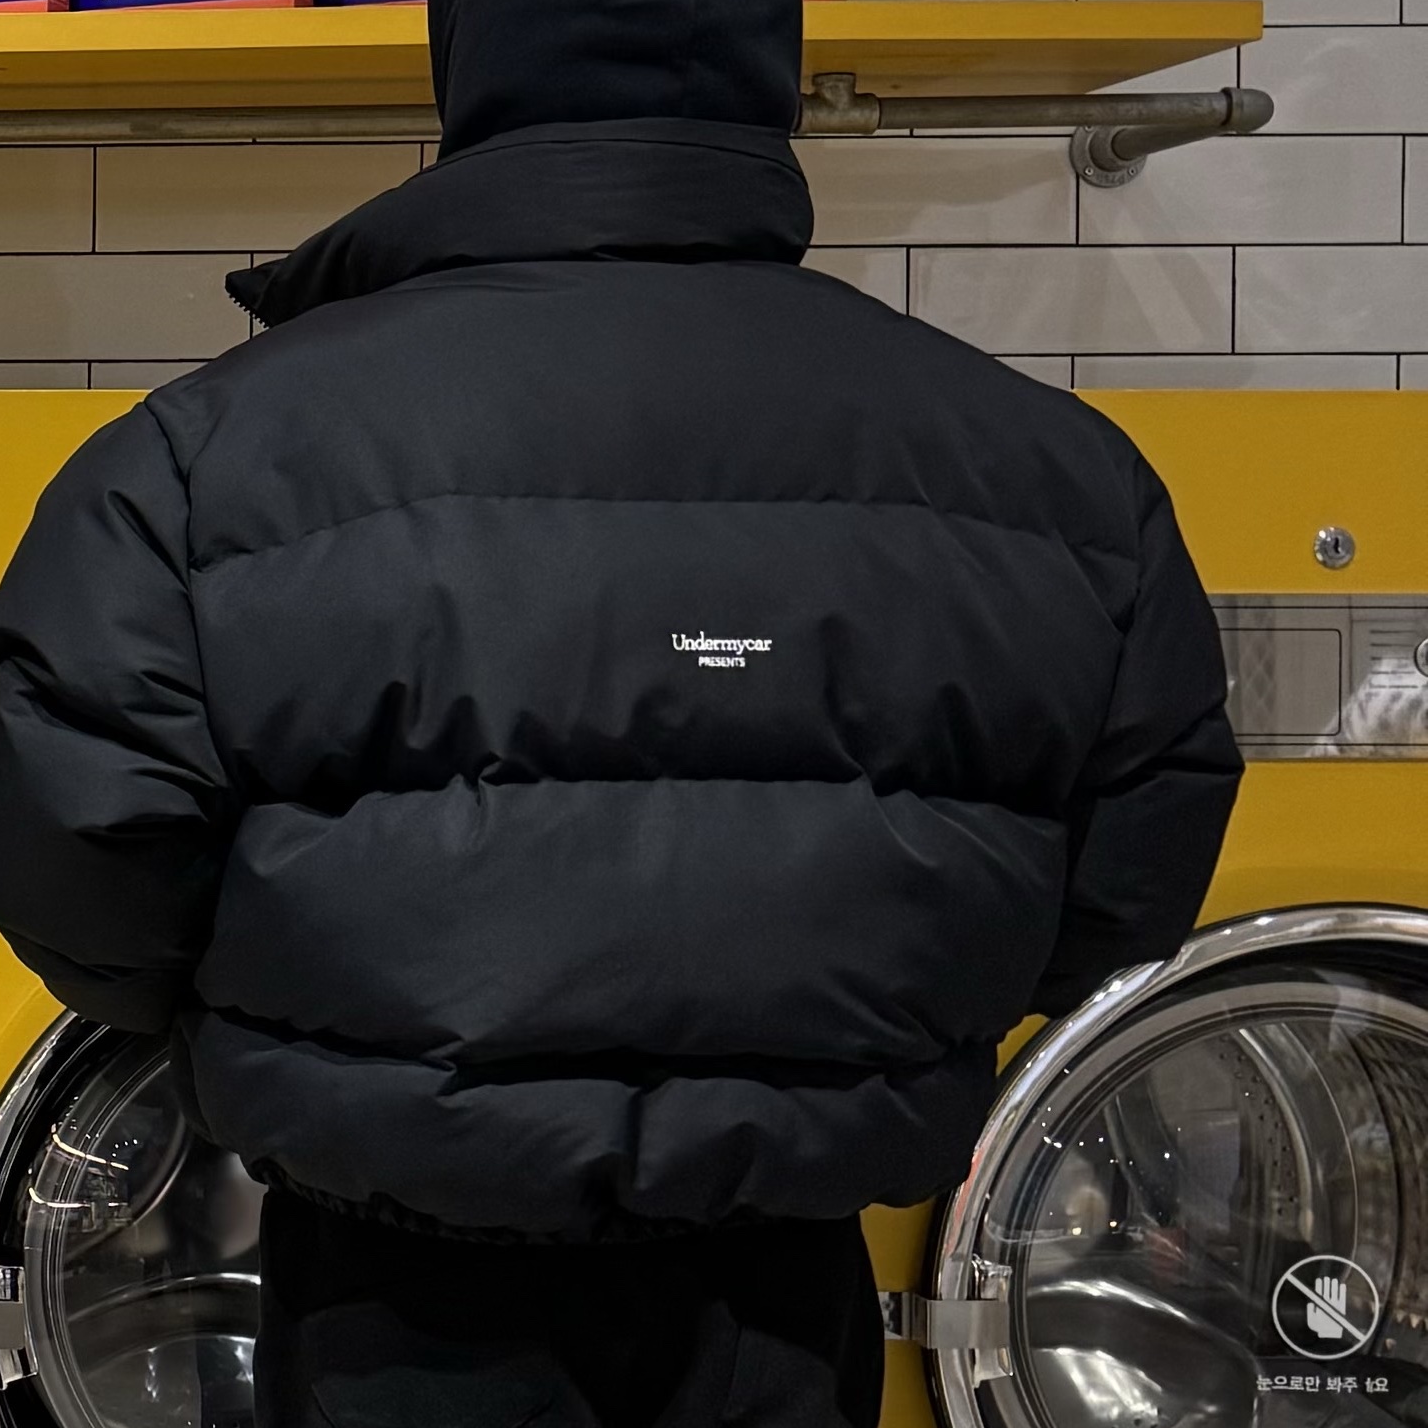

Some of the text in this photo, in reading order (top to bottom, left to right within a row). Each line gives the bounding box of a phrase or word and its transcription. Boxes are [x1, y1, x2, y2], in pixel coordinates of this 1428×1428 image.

[671, 630, 773, 655] Undermycar
[698, 656, 746, 668] PRESENTS
[1255, 1374, 1321, 1392] 눈으로만
